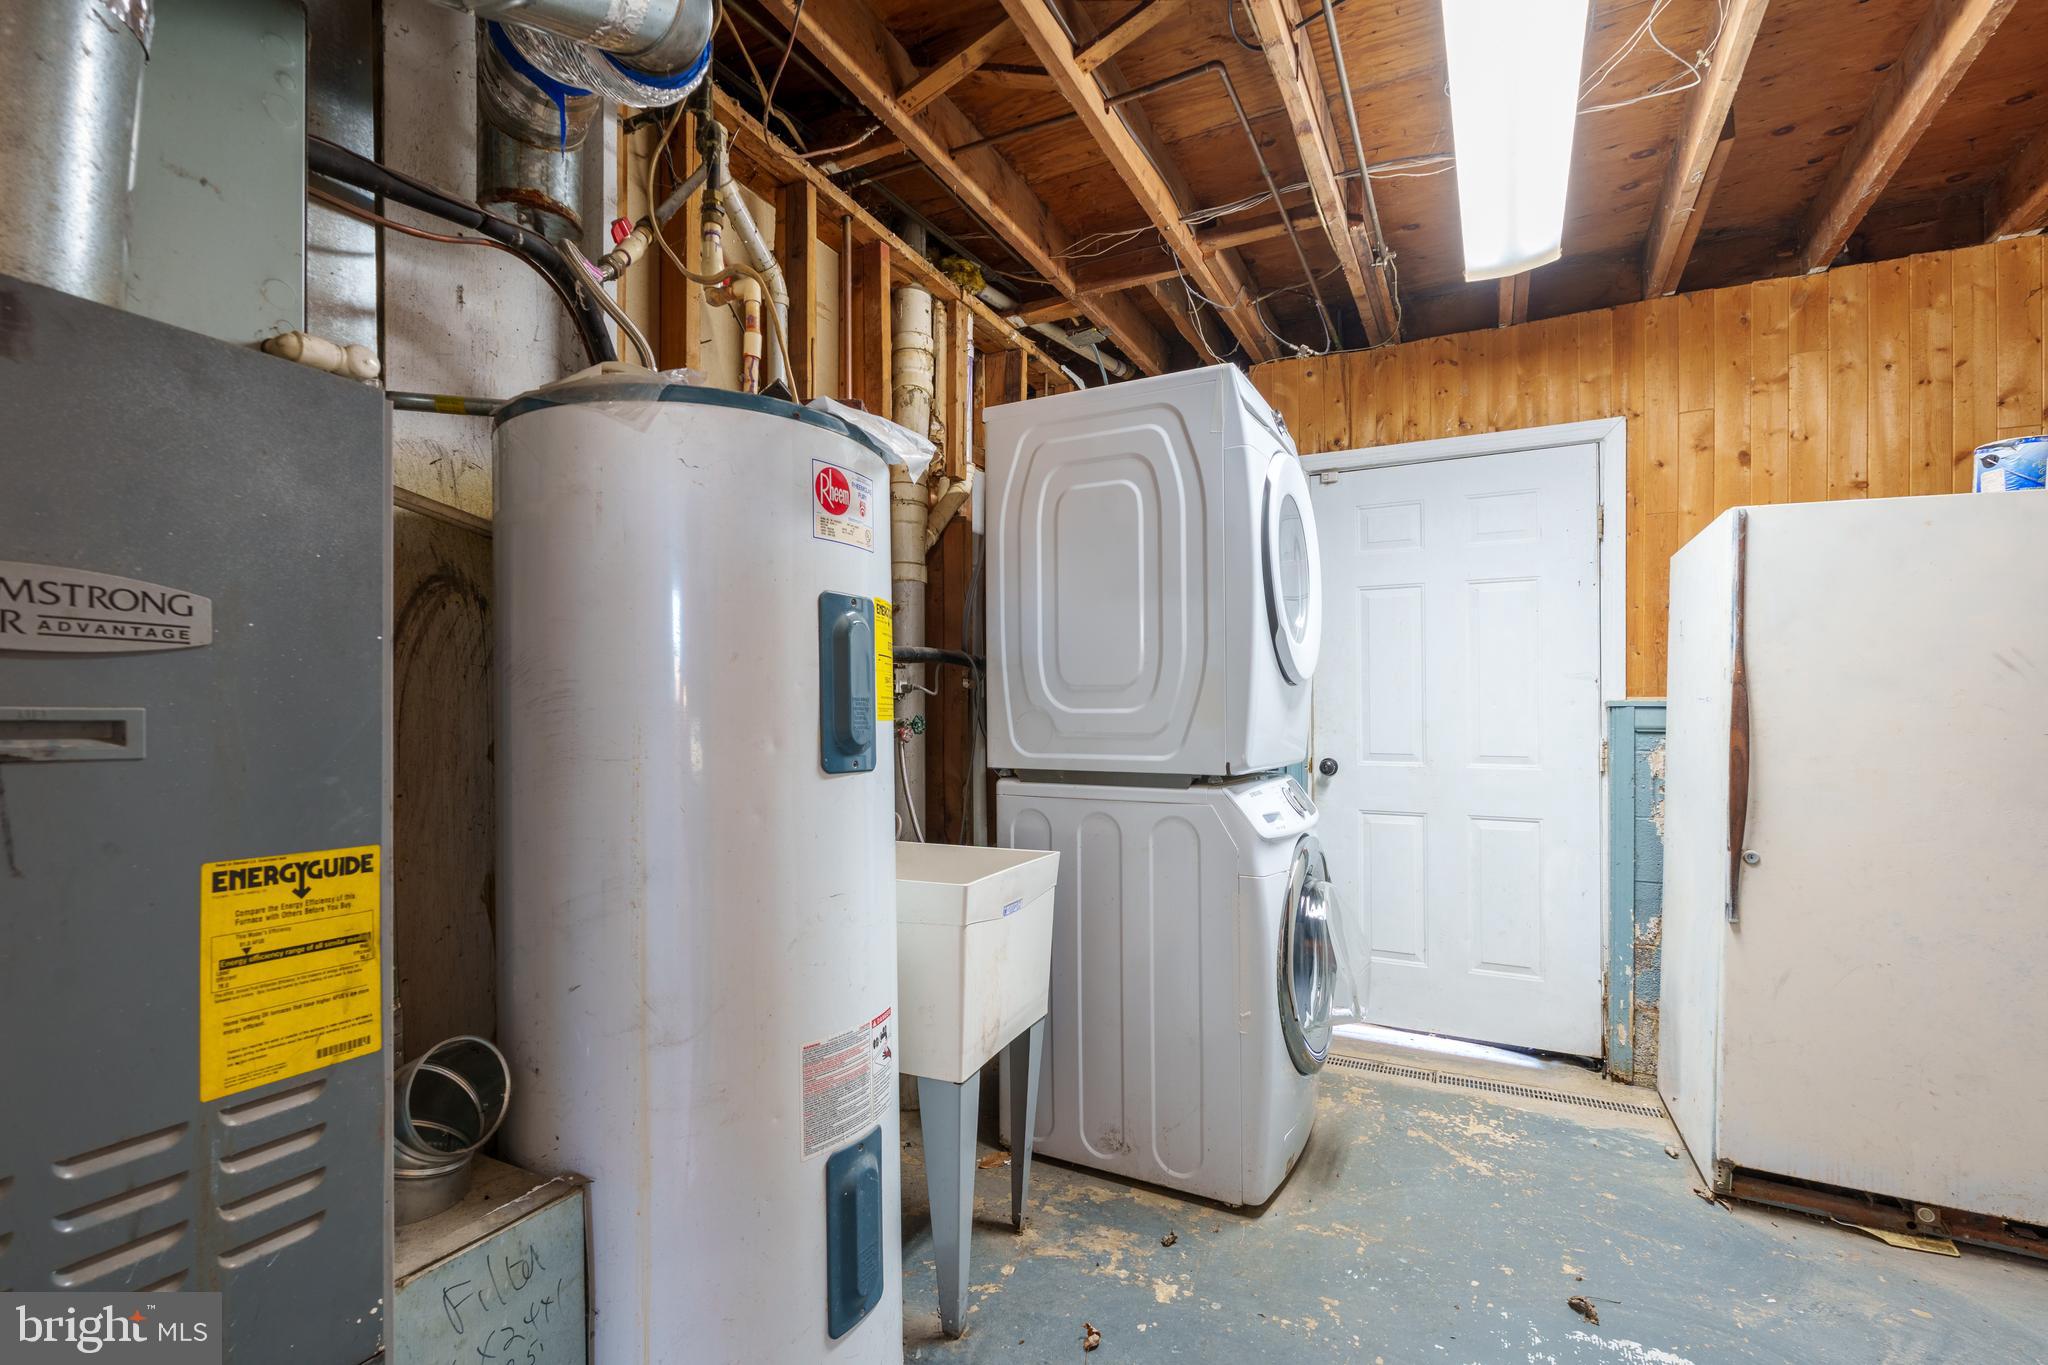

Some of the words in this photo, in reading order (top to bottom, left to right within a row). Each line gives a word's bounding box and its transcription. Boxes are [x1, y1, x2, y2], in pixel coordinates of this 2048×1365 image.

[820, 469, 849, 510] Rheem
[38, 619, 191, 641] ADVANTAGE
[212, 854, 374, 897] ENERGYGUIDE
[235, 907, 266, 918] Compare
[268, 905, 279, 913] the
[281, 902, 303, 911] Energy
[305, 897, 335, 907] Efficiency
[235, 917, 263, 926] Furnace
[266, 913, 279, 921] with
[281, 909, 302, 918] Others
[305, 906, 325, 915] Before
[340, 902, 351, 911] Buy
[220, 957, 247, 968] Energy
[249, 951, 284, 963] efficiency
[285, 947, 305, 957] range
